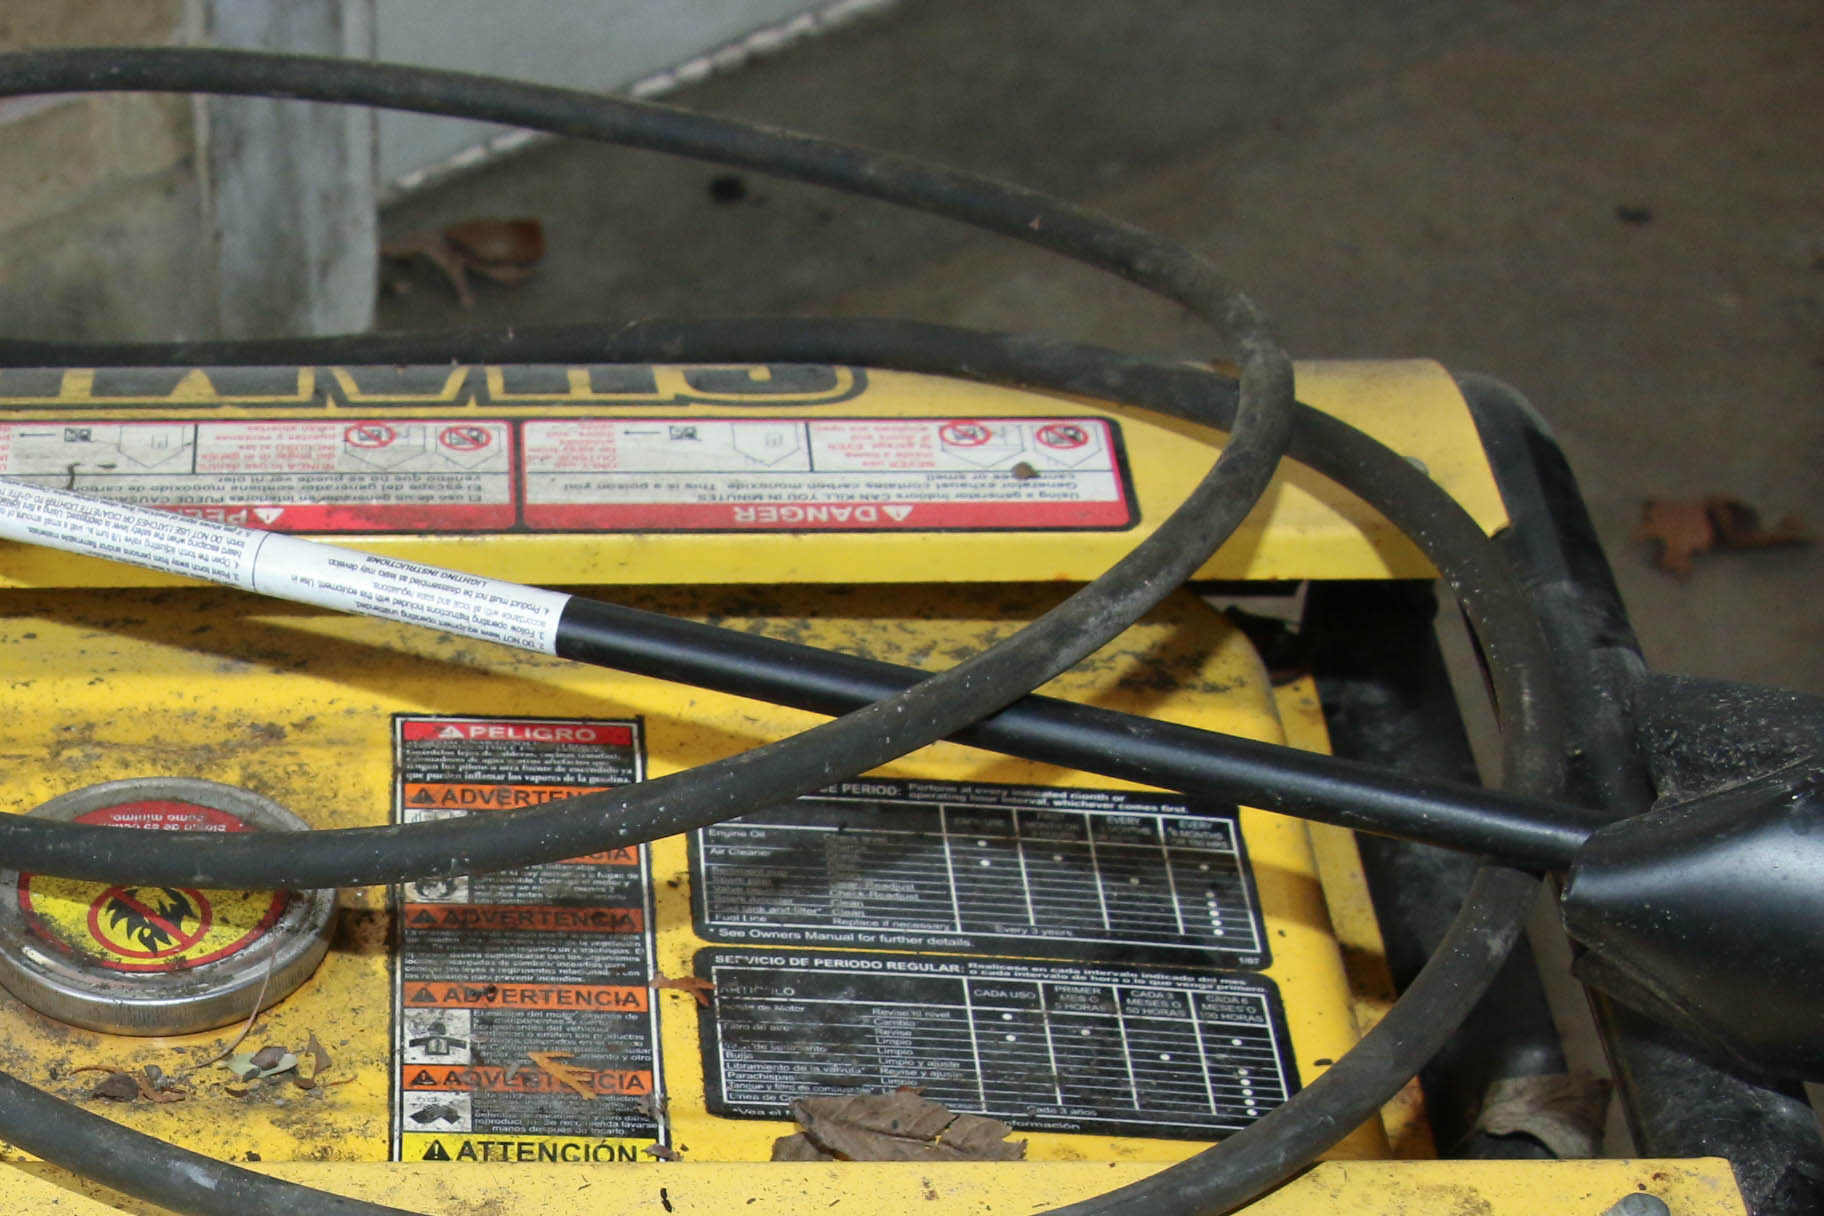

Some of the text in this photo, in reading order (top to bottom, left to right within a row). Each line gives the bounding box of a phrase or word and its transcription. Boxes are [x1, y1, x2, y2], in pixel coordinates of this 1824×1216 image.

[598, 480, 1077, 490] Generator exhaust contains carbon This poison
[1038, 491, 1079, 500] Using
[733, 506, 878, 522] DANGER
[193, 530, 222, 545] DO NOT
[366, 555, 487, 589] LIGHTING INSTRUCTIONS
[328, 558, 540, 615] Product must not be develop
[426, 606, 535, 638] Follow operating instructions
[503, 634, 535, 648] DO NOT
[469, 726, 596, 741] PELIGRO
[464, 772, 506, 780] inflamar
[524, 774, 561, 783] vapores
[1053, 799, 1115, 810] whichever
[1118, 803, 1157, 811] comes
[709, 829, 747, 839] Engine
[710, 848, 771, 858] Air Cleaner
[441, 909, 636, 928] ADVERTENCIA
[833, 917, 878, 927] Replace
[997, 925, 1028, 936] Every
[1041, 930, 1072, 939] years
[719, 929, 975, 947] See Owners Manual for further details.
[789, 957, 810, 967] DE
[813, 958, 883, 970] PERIODO
[887, 961, 966, 974] REGULAR:
[1049, 967, 1079, 975] cada
[1083, 969, 1138, 978] intervalo
[1140, 972, 1192, 981] indicado
[974, 989, 1036, 1000] CADA USO
[1055, 985, 1102, 995] PRIMER
[1130, 990, 1158, 999] CADA
[442, 986, 641, 1007] ADVERTENCIA
[1206, 995, 1234, 1004] CADA
[1127, 999, 1166, 1008] MESES
[1201, 1004, 1241, 1013] MESES
[922, 1011, 951, 1019] nivel
[1145, 1007, 1186, 1017] HORAS
[1221, 1013, 1264, 1023] HORAS
[874, 1028, 912, 1037] Revise
[875, 1038, 912, 1047] Limpio
[876, 1048, 914, 1057] Limpio
[726, 1062, 790, 1073] Libramiento
[878, 1057, 960, 1069] Limpio ajuste
[726, 1072, 795, 1083] Parachispas
[879, 1067, 918, 1077] Revise
[880, 1077, 918, 1087] Limpio
[1027, 1105, 1097, 1116] Cada años
[456, 1139, 637, 1162] ATTENCIÓN
